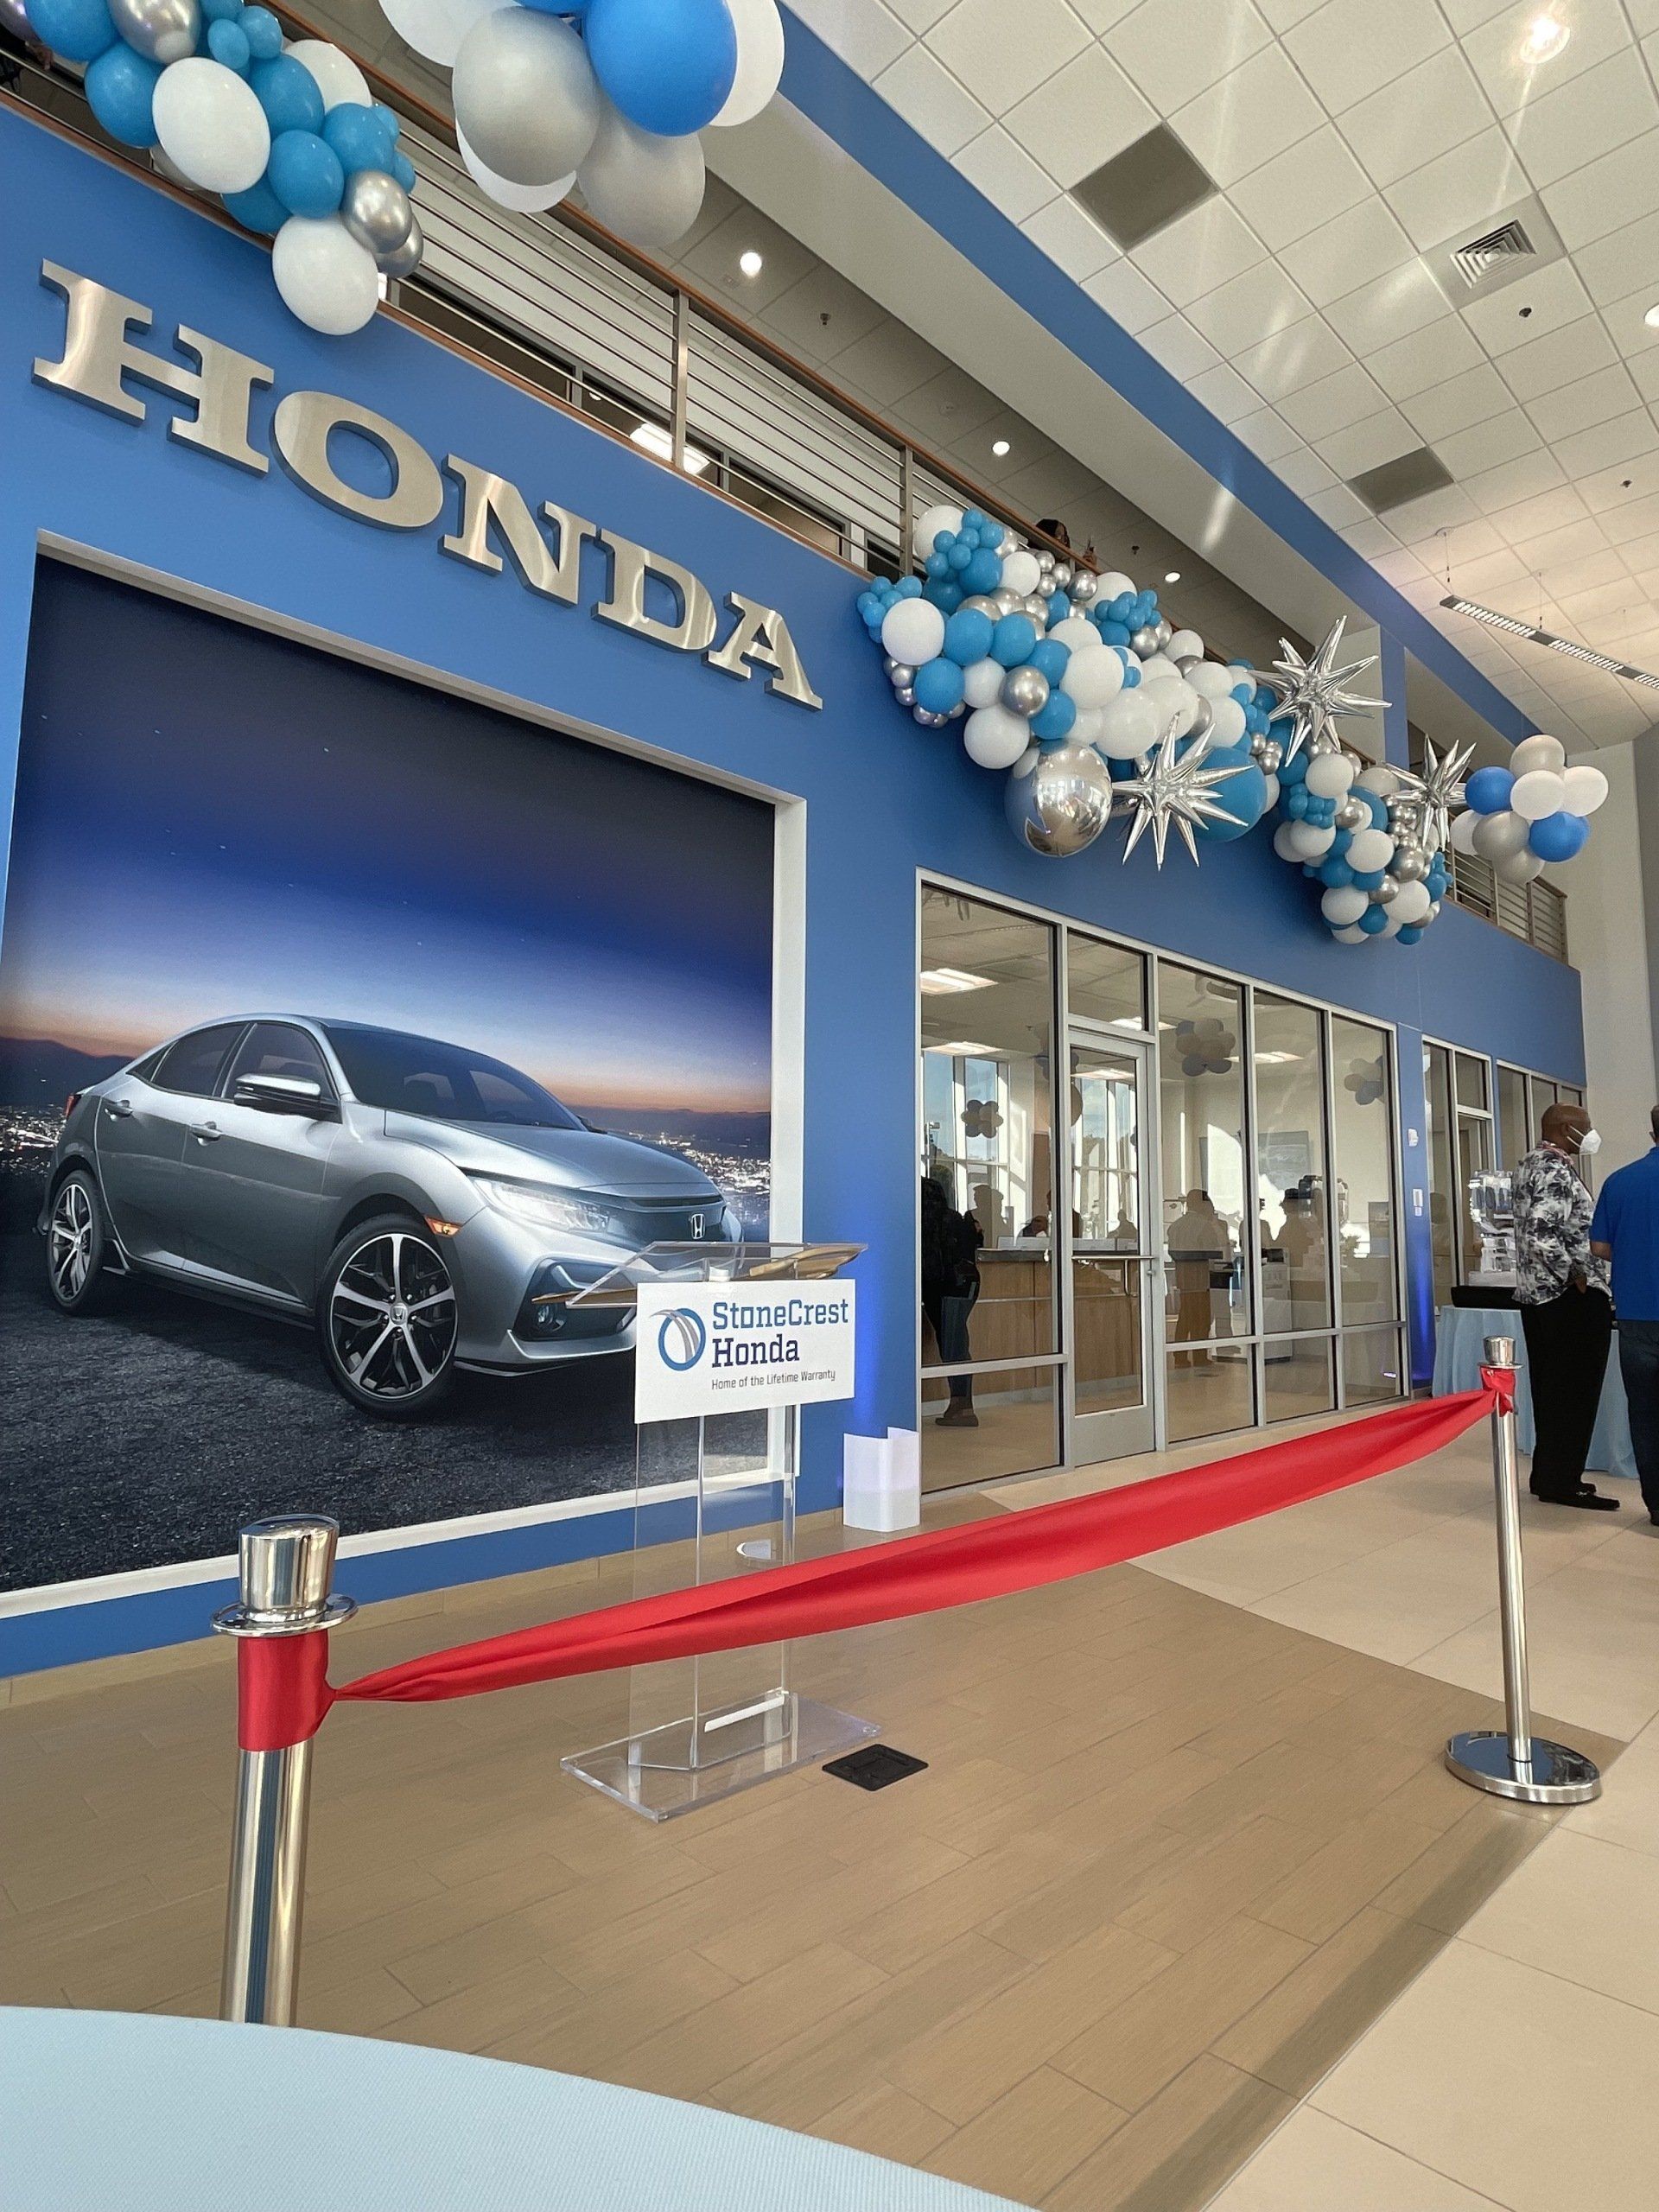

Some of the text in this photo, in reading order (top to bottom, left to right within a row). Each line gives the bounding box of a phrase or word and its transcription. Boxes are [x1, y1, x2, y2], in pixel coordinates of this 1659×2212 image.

[33, 259, 823, 710] HONDA
[713, 1299, 849, 1330] StoneCrest
[712, 1333, 800, 1368] Honda
[712, 1369, 836, 1389] Home of the Lifetime Warranty
